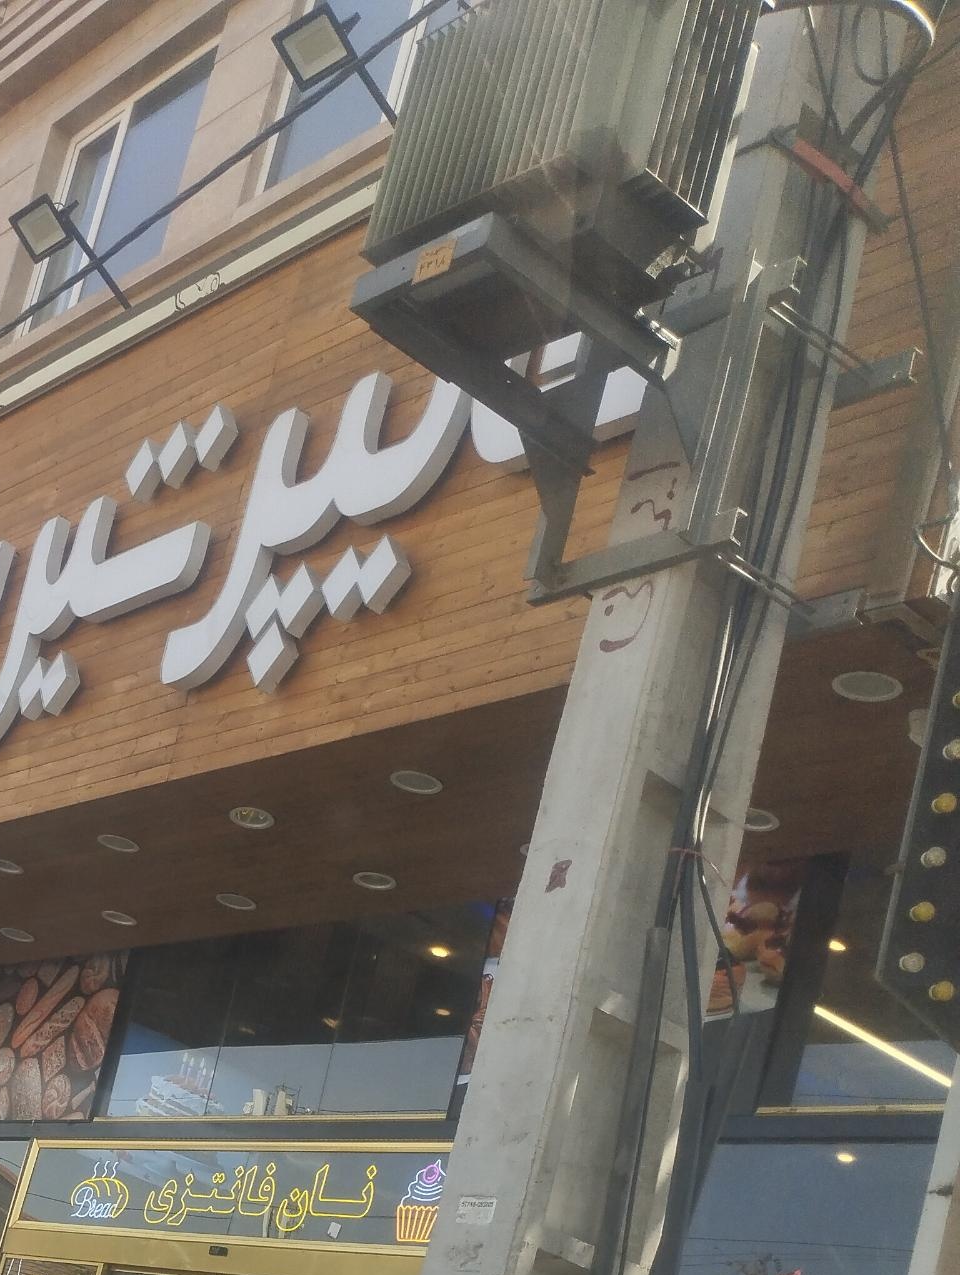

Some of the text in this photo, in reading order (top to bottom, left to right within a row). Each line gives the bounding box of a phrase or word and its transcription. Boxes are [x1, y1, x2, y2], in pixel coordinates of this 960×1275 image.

[71, 1186, 119, 1219] Bread
[144, 1161, 377, 1232] نان فانتزی
